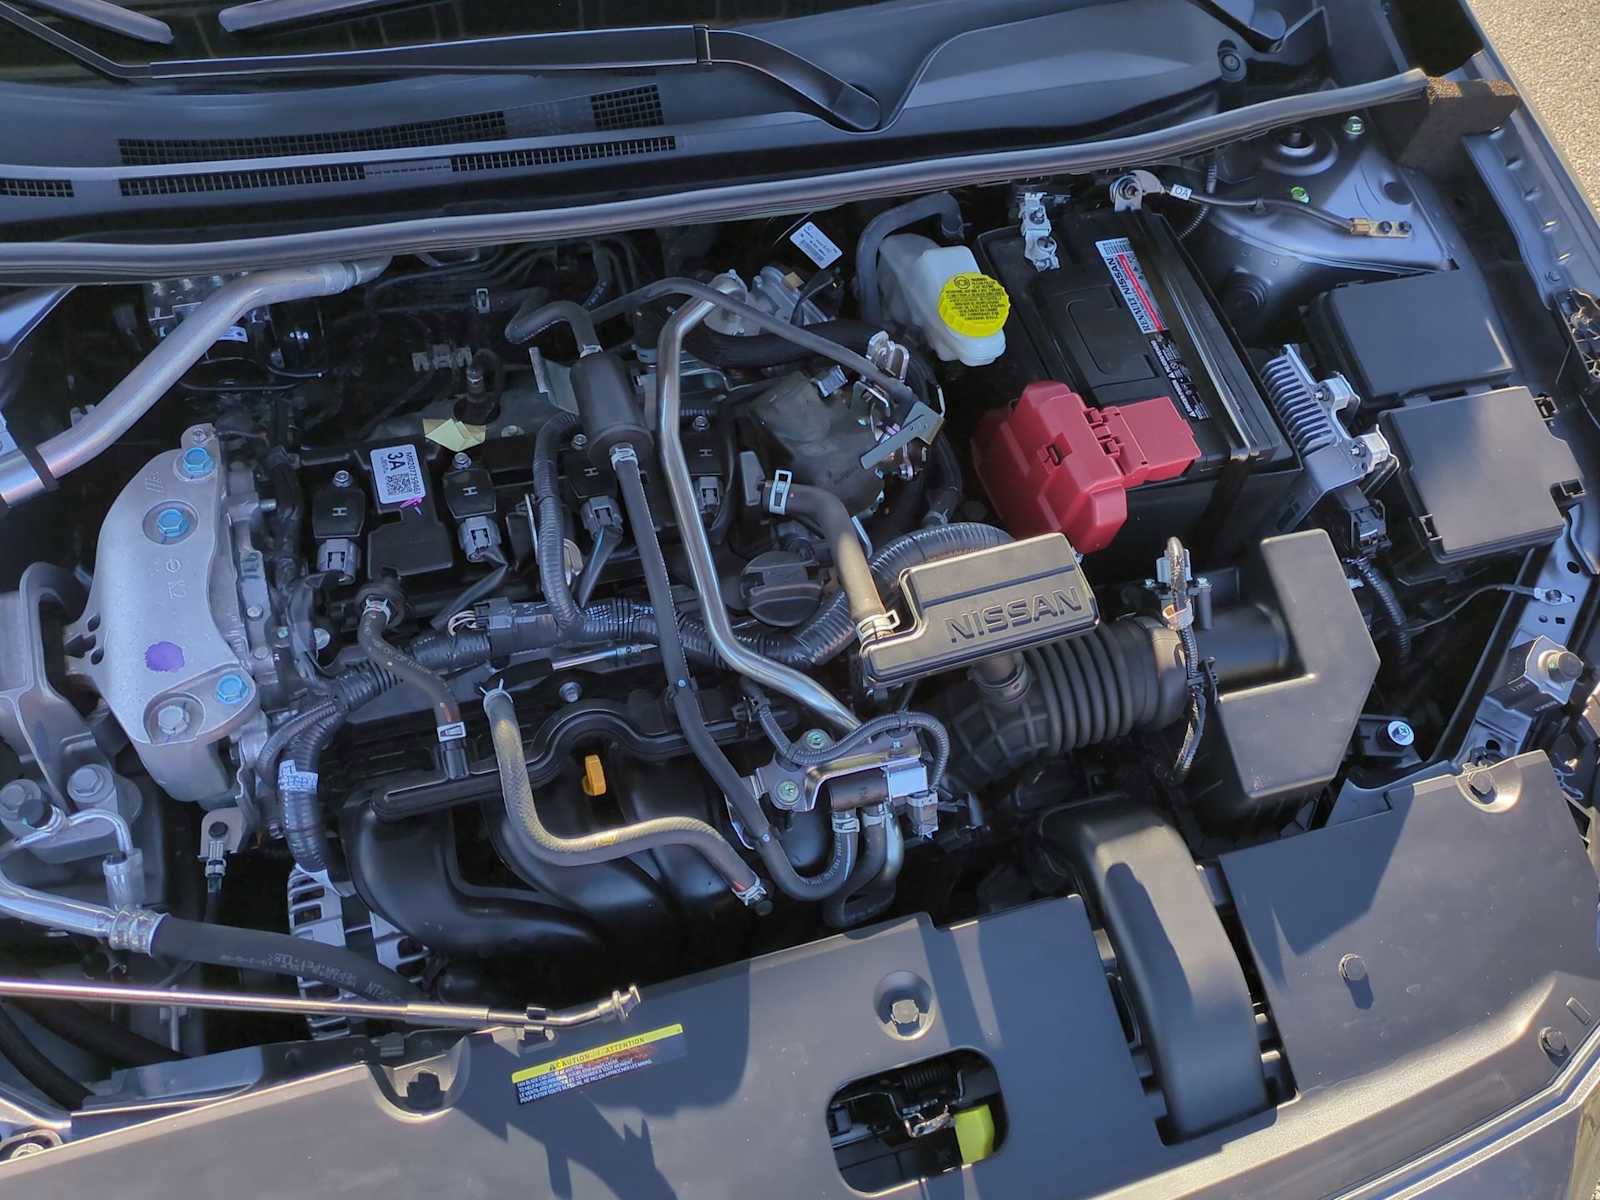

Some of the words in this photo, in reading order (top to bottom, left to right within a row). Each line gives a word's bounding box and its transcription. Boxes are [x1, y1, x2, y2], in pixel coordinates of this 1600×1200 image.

[1106, 257, 1131, 295] NISSAN
[387, 452, 405, 470] 3A
[943, 585, 1082, 643] NISSAN
[605, 1037, 644, 1053] ATTENTION
